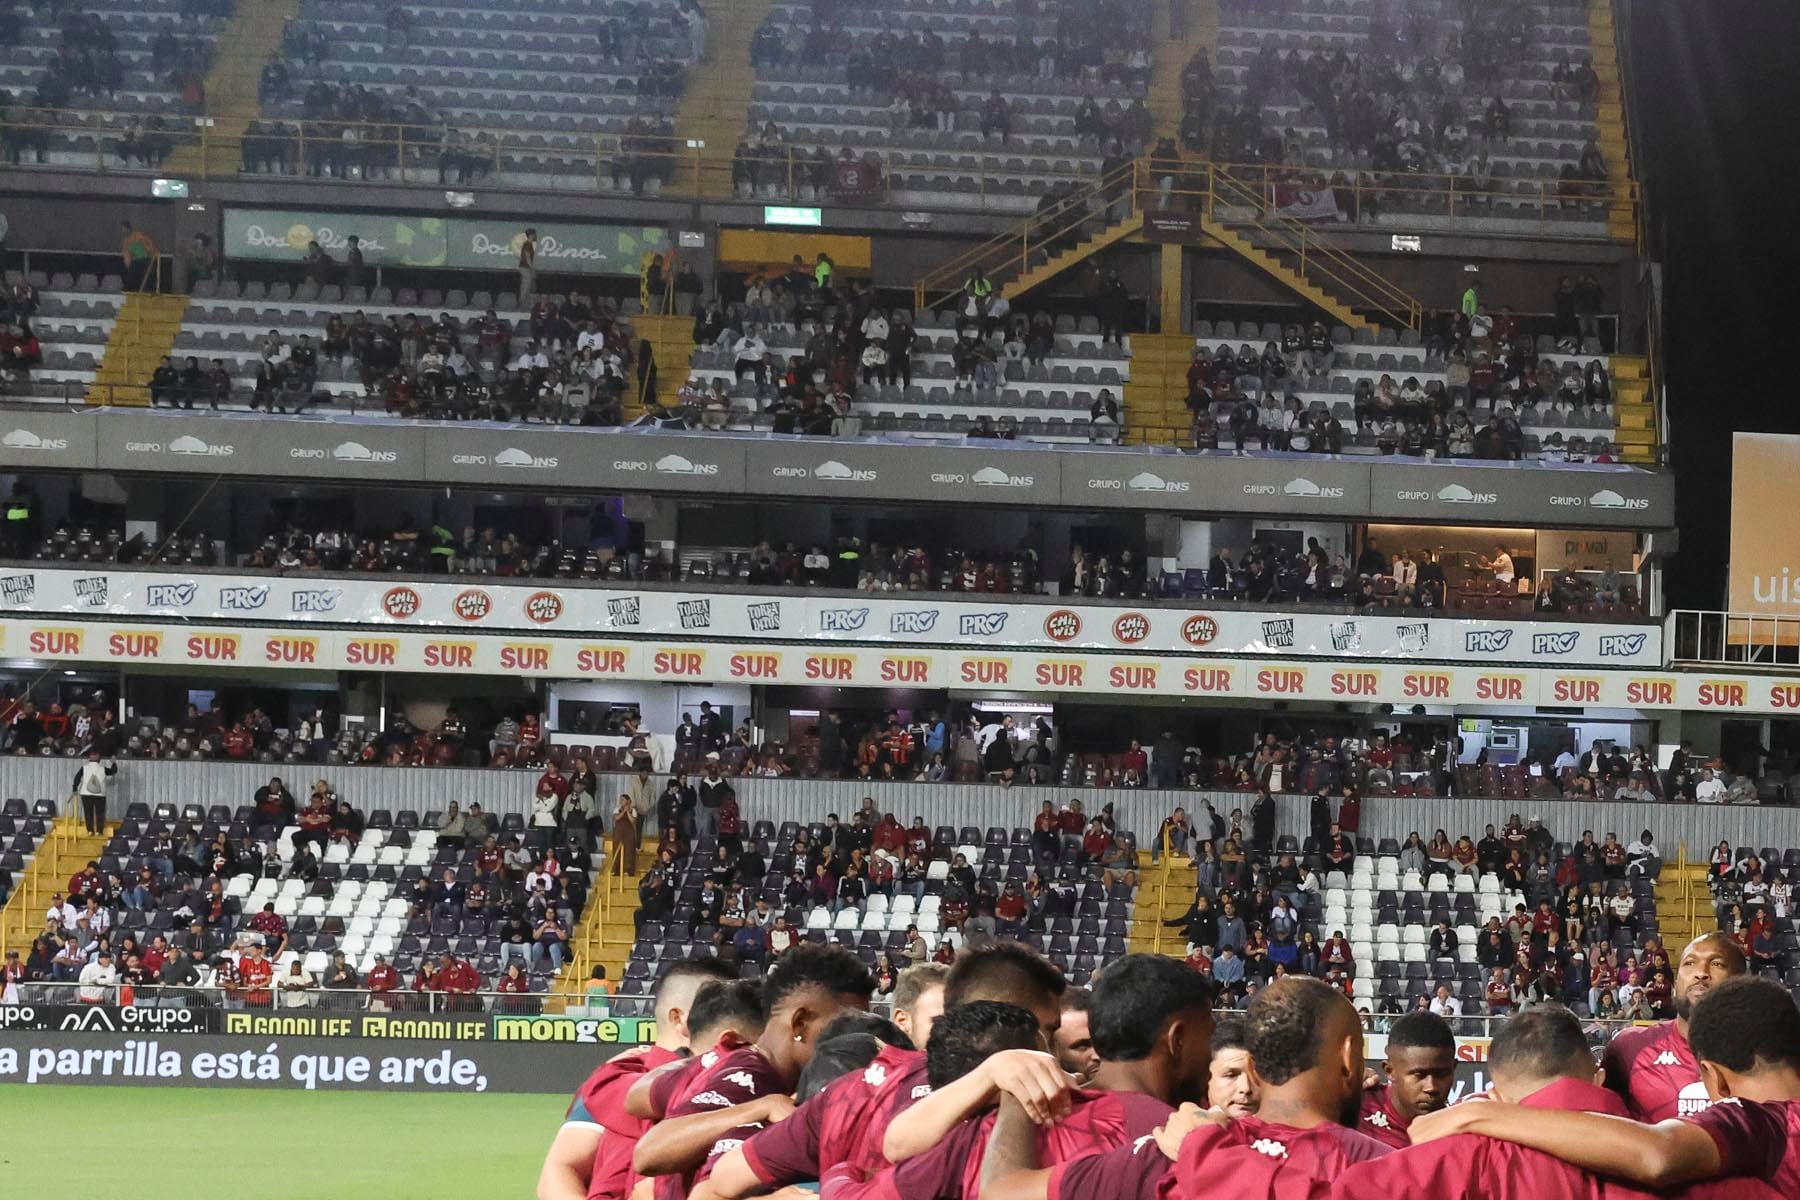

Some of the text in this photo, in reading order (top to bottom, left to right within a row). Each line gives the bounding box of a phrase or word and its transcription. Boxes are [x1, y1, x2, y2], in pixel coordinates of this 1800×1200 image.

[247, 225, 288, 247] Dos
[472, 233, 607, 261] Dos Pinos
[126, 441, 234, 455] GRUPO INS
[290, 447, 397, 461] GRUPO INS
[453, 454, 559, 467] GRUPO INS
[613, 460, 718, 474] GRUPO INS
[773, 466, 877, 480] GRUPO INS
[931, 473, 1034, 486] GRUPO INS
[1088, 479, 1190, 492] GRUPO INS
[1243, 485, 1344, 498] GRUPO INS
[1397, 491, 1497, 503] GRUPO INS
[1550, 496, 1649, 509] GRUPO INS
[30, 632, 79, 655] SUR
[110, 633, 158, 658] SUR
[187, 636, 237, 660] SUR
[265, 639, 315, 664] SUR
[346, 642, 394, 664] SUR
[424, 644, 472, 667] SUR
[500, 647, 547, 669] SUR
[577, 650, 625, 673] SUR
[654, 652, 702, 675] SUR
[730, 654, 778, 677] SUR
[805, 656, 852, 680] SUR
[881, 659, 929, 682] SUR
[960, 660, 1008, 683] SUR
[1037, 663, 1083, 686] SUR
[1109, 666, 1157, 690] SUR
[1184, 668, 1231, 691] SUR
[1257, 670, 1304, 693] SUR
[1331, 672, 1378, 694] SUR
[1403, 674, 1449, 698] SUR
[1476, 678, 1522, 700] SUR
[1554, 680, 1601, 702] SUR
[1626, 682, 1671, 704] SUR
[1698, 684, 1743, 706] SUR
[121, 1005, 192, 1027] Grupo
[497, 1017, 619, 1044] monge
[26, 1040, 182, 1083] parrilla
[191, 1043, 280, 1080] está
[290, 1054, 371, 1089] que
[379, 1050, 488, 1092] arde,
